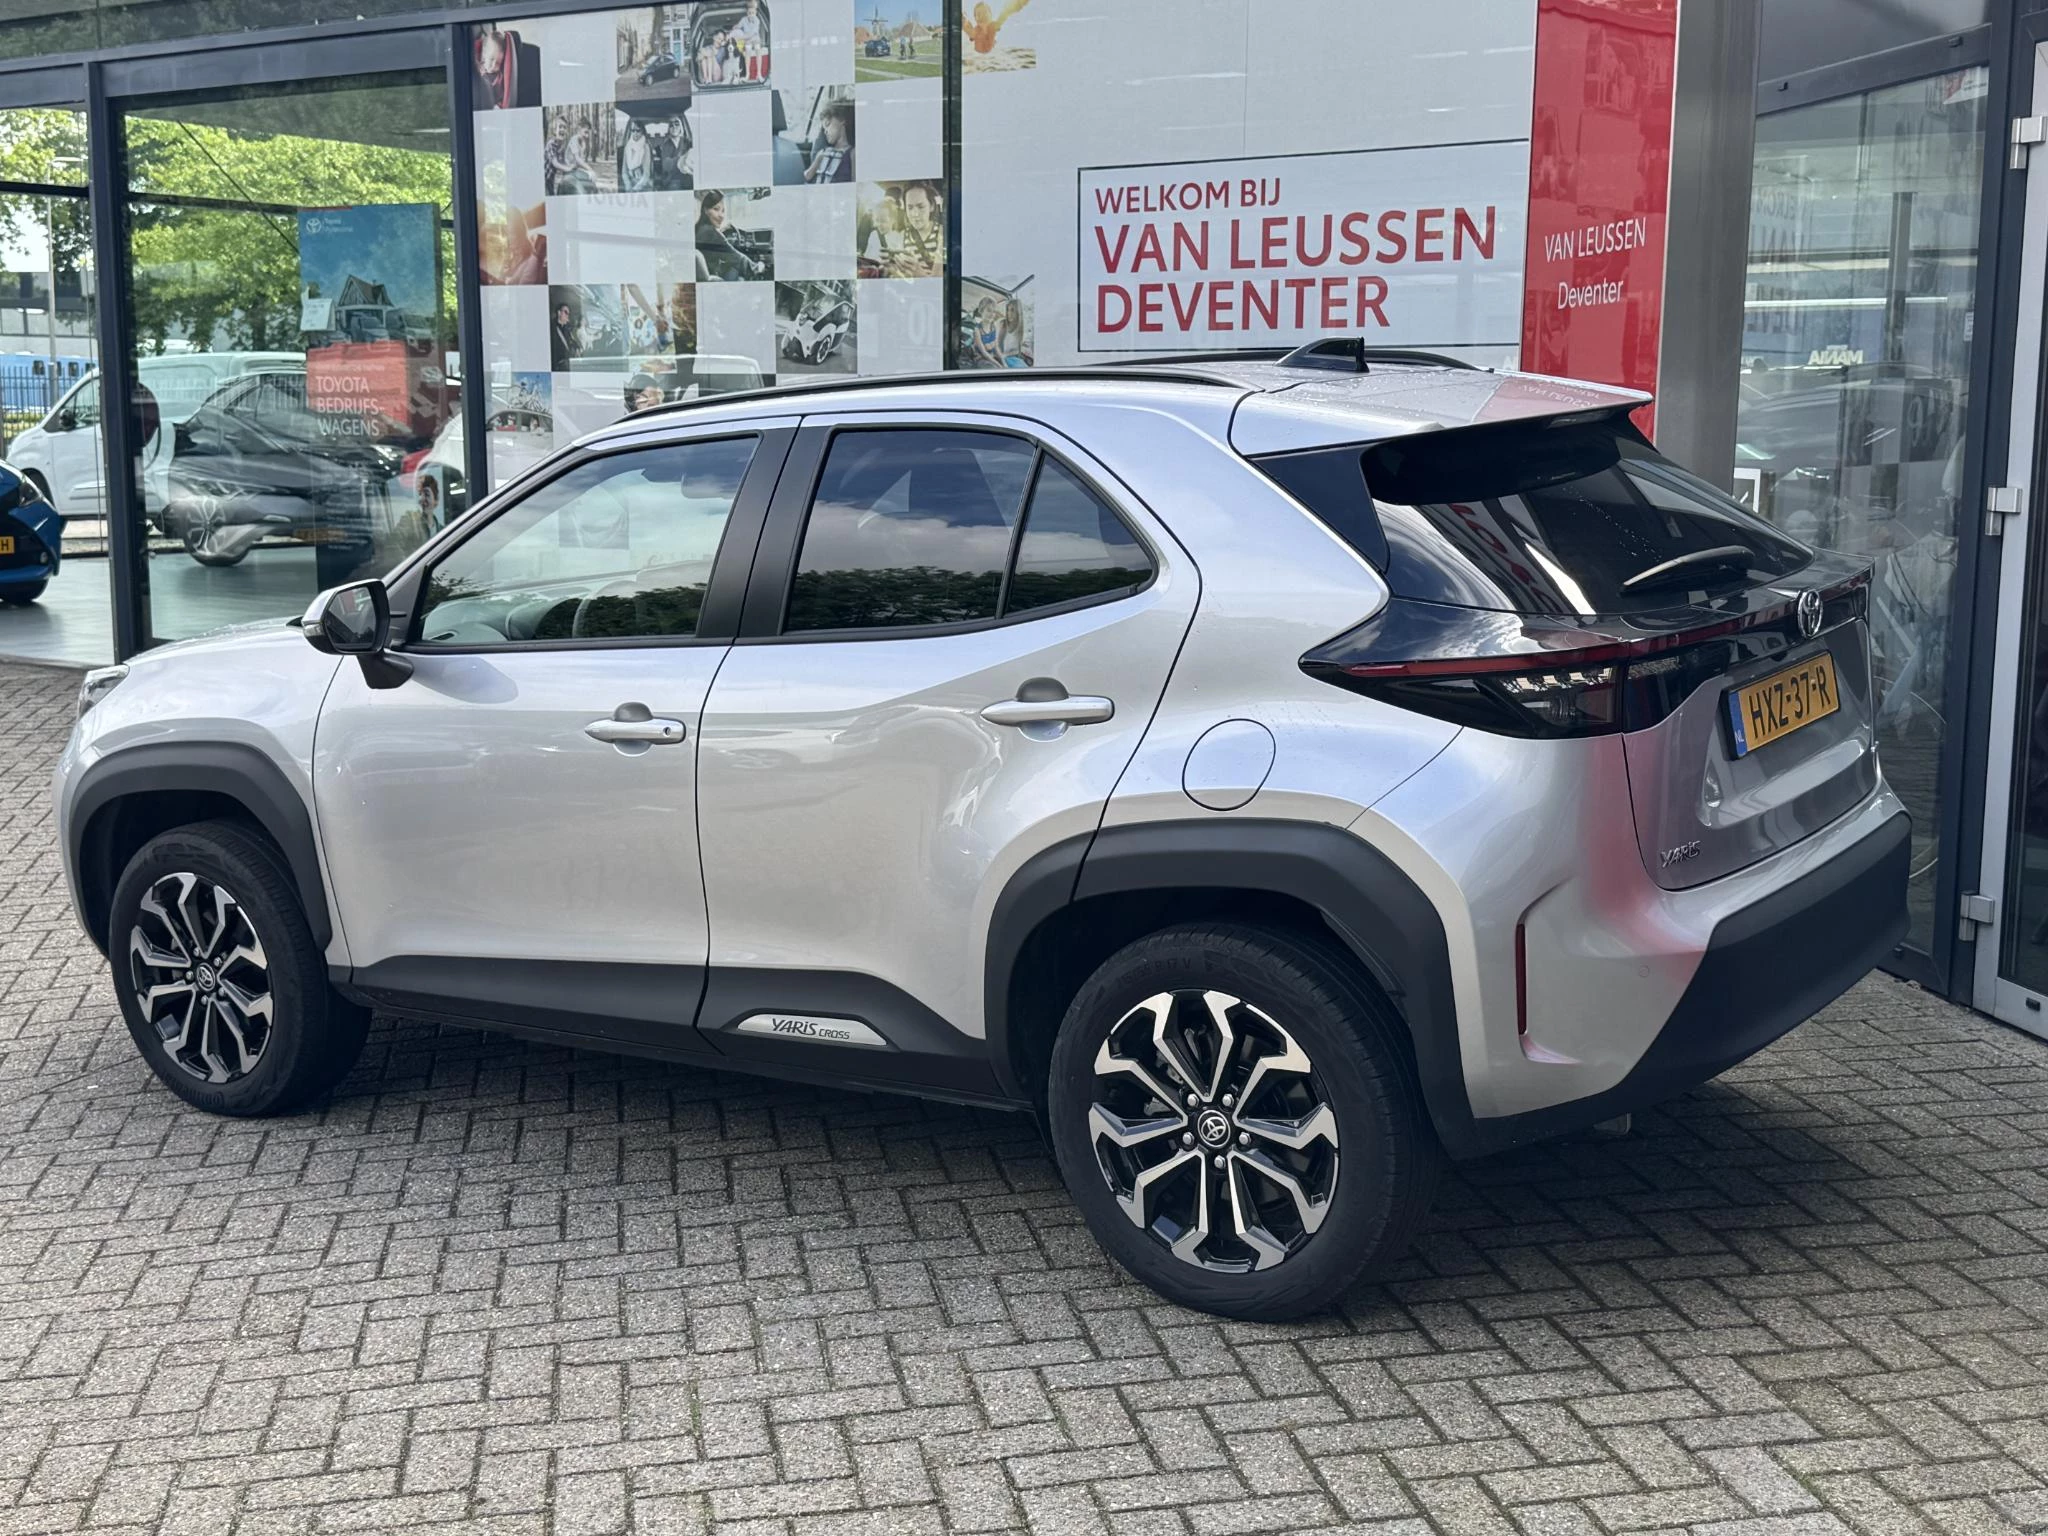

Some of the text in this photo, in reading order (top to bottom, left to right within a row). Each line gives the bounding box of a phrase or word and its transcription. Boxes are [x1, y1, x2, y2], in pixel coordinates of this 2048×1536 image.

[1095, 177, 1281, 215] WELKOM BIJ
[1094, 205, 1496, 274] VAN LEUSSEN
[1544, 216, 1647, 263] VAN LEUSSEN
[1097, 275, 1391, 334] DEVENTER
[1557, 276, 1624, 310] Deventer
[315, 375, 371, 394] TOYOTA
[317, 418, 380, 437] WAGENS
[1748, 665, 1832, 739] HXZ-37-R
[818, 1028, 851, 1040] CROSS
